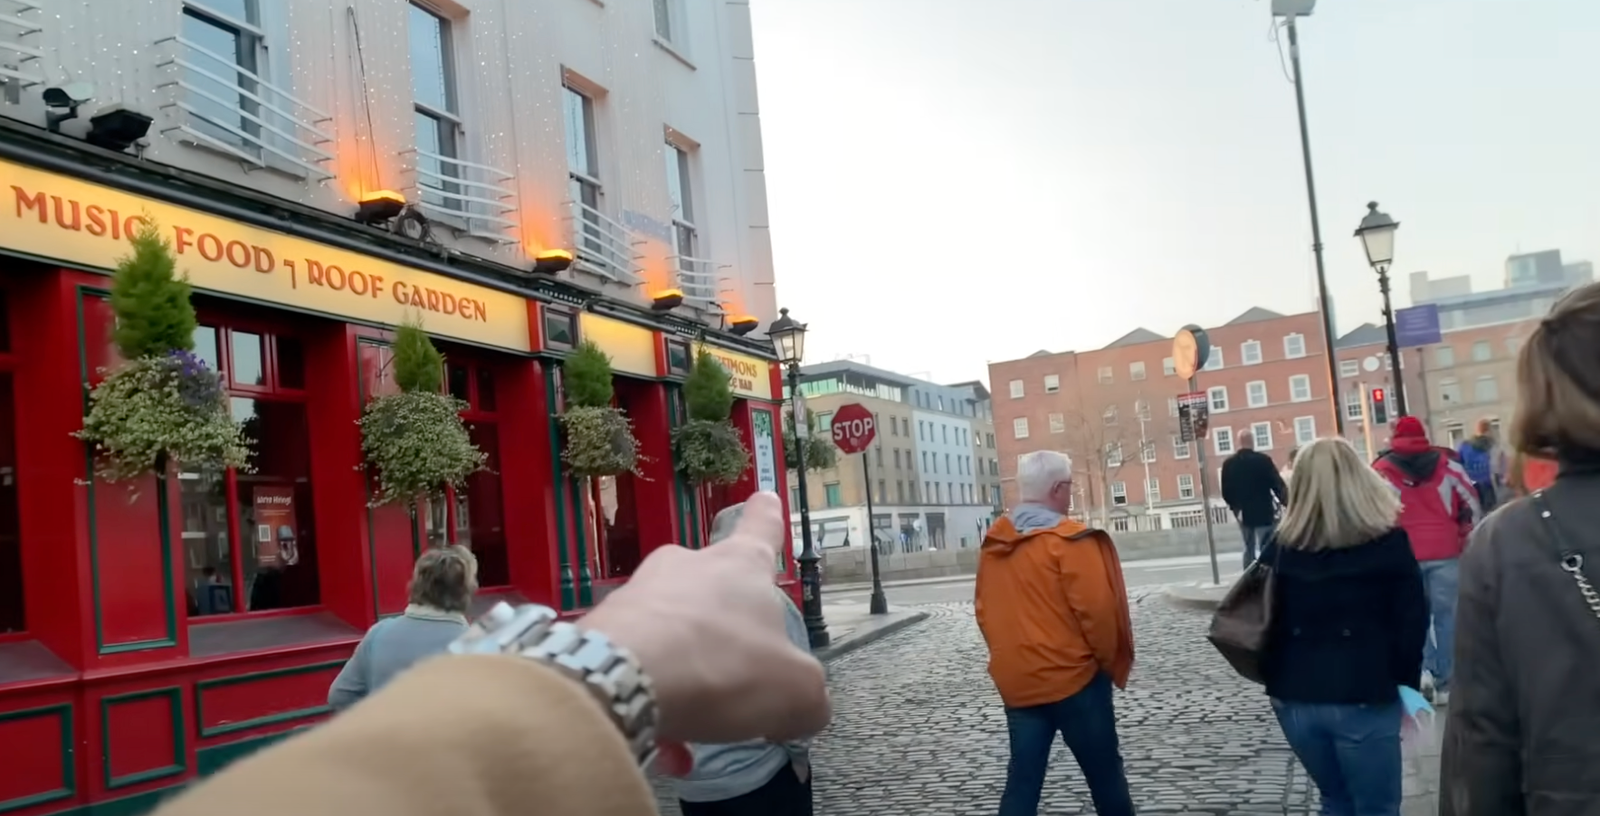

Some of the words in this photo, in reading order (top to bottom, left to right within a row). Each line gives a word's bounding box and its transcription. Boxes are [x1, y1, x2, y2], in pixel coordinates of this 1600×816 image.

[10, 184, 150, 243] MUSIC
[172, 225, 275, 274] FOOD
[304, 258, 385, 299] ROOF
[392, 281, 488, 323] GARDEN
[833, 417, 874, 441] STOP
